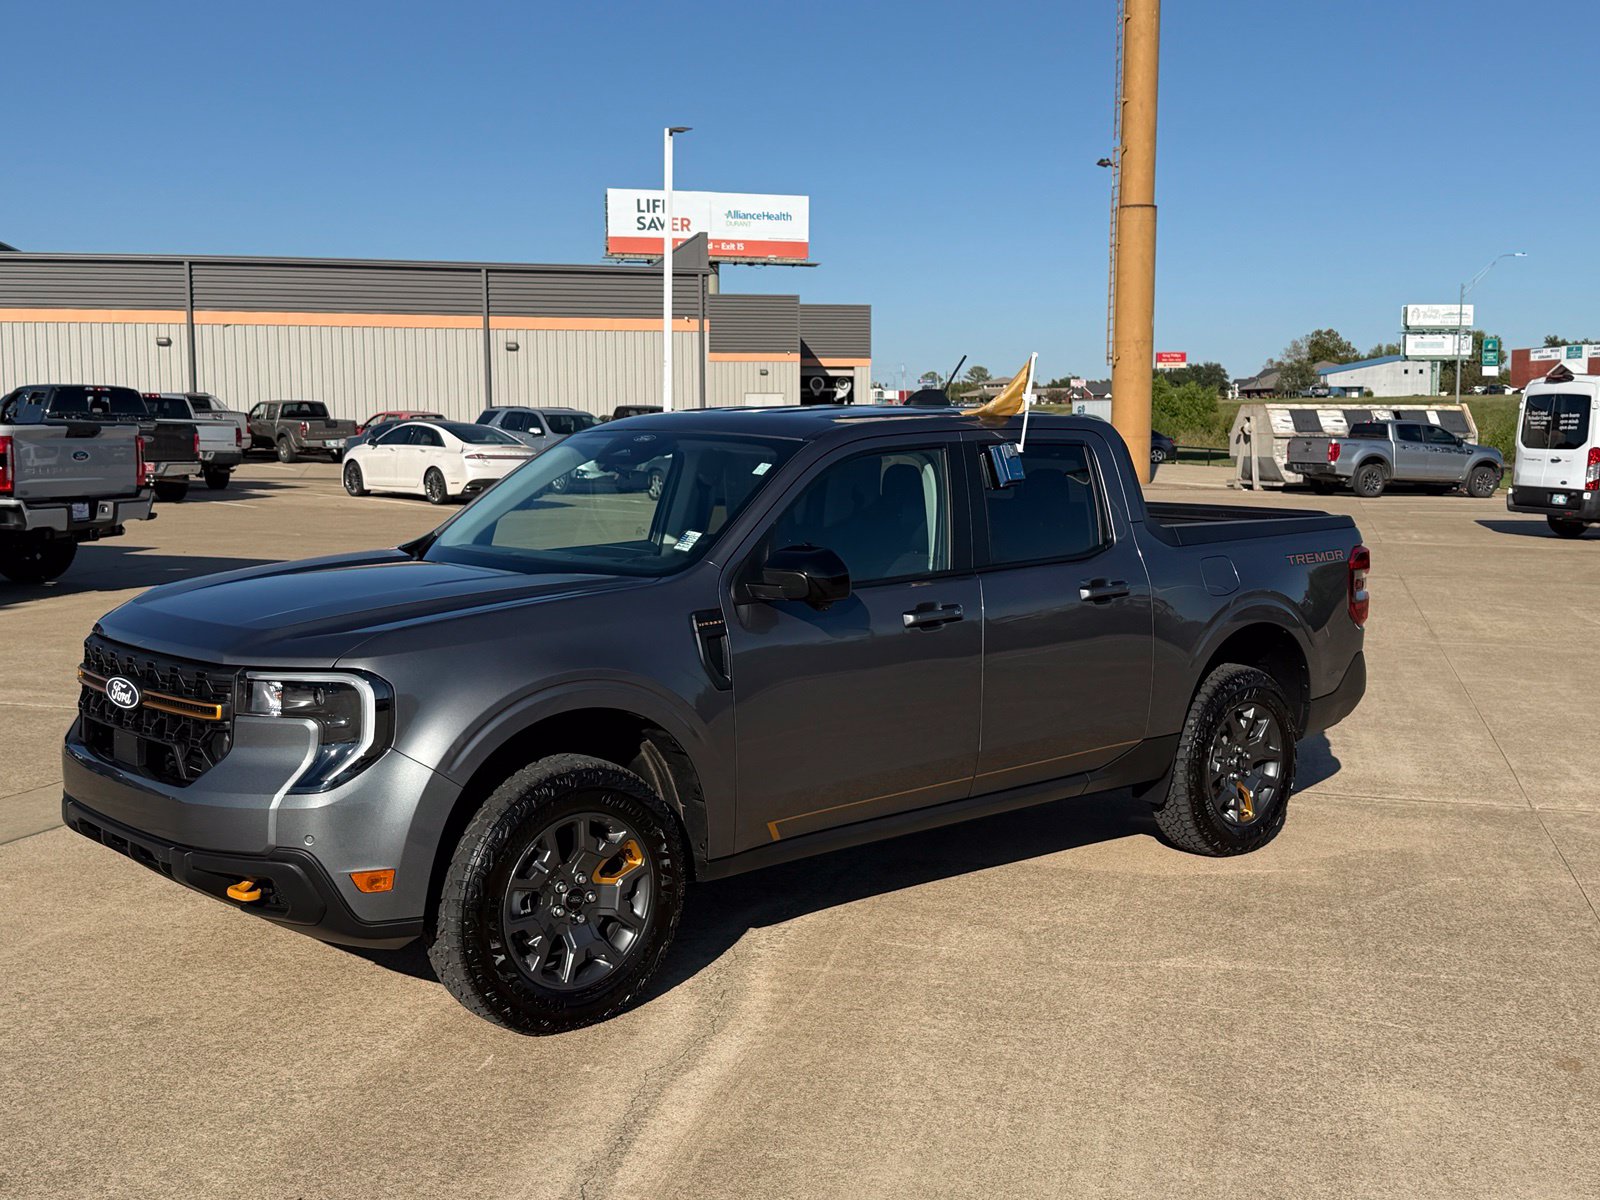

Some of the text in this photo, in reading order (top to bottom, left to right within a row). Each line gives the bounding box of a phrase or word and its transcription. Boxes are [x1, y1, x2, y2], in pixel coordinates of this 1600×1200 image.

[636, 198, 665, 214] LIF
[725, 209, 792, 221] AllianceHealth
[636, 215, 692, 232] SAVER
[721, 241, 736, 251] Exit
[736, 242, 745, 251] 15
[1286, 549, 1344, 566] TREMOR
[111, 680, 132, 705] Ford
